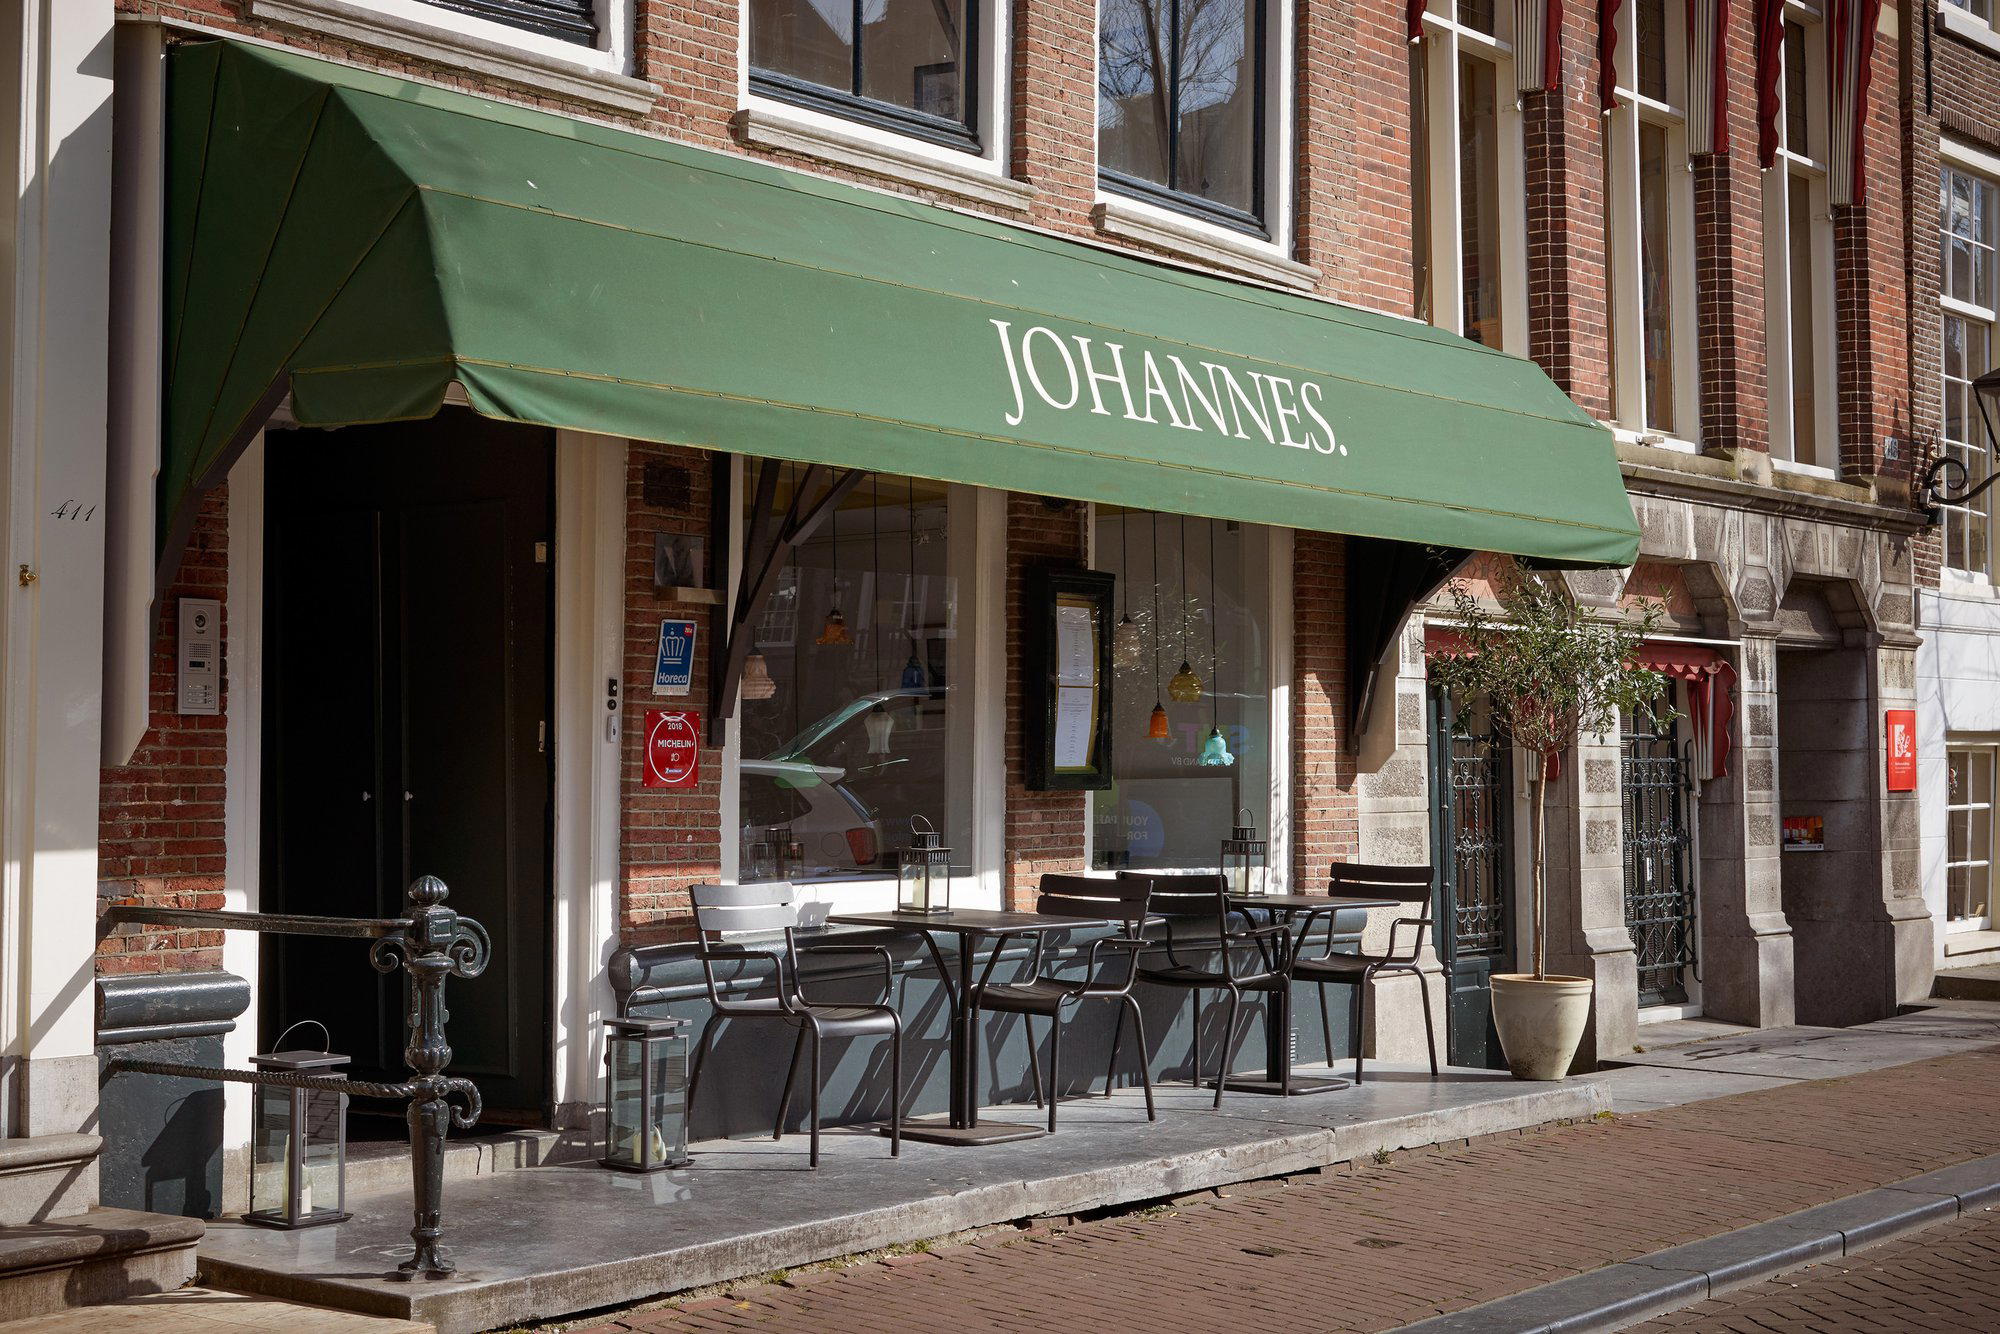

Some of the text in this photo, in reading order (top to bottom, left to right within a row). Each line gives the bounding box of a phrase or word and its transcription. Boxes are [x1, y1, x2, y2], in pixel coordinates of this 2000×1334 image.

[989, 318, 1349, 457] JOHANNES.
[51, 499, 97, 522] 411
[657, 672, 688, 684] Horeca
[667, 722, 683, 731] 2018
[657, 739, 692, 748] MICHELIN
